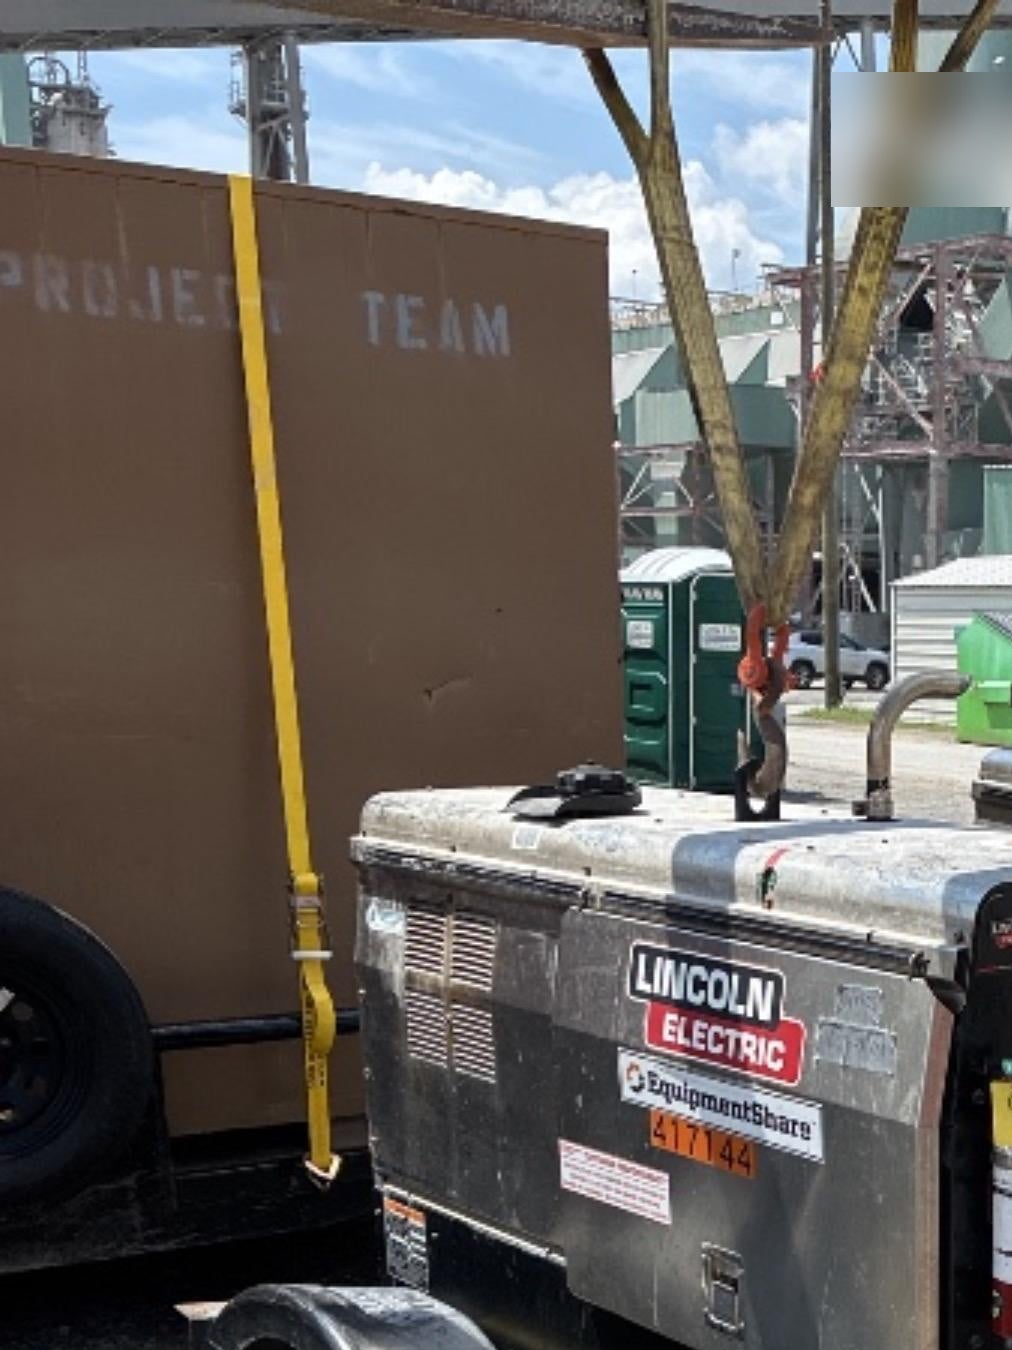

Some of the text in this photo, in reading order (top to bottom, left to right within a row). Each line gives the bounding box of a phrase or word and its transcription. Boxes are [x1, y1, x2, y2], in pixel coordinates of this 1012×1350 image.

[361, 290, 511, 357] TEAM
[635, 952, 775, 1022] LINCOLN
[662, 1012, 786, 1072] ELECTRIC
[647, 1070, 813, 1141] EquipmentShare
[653, 1115, 752, 1176] 417144
